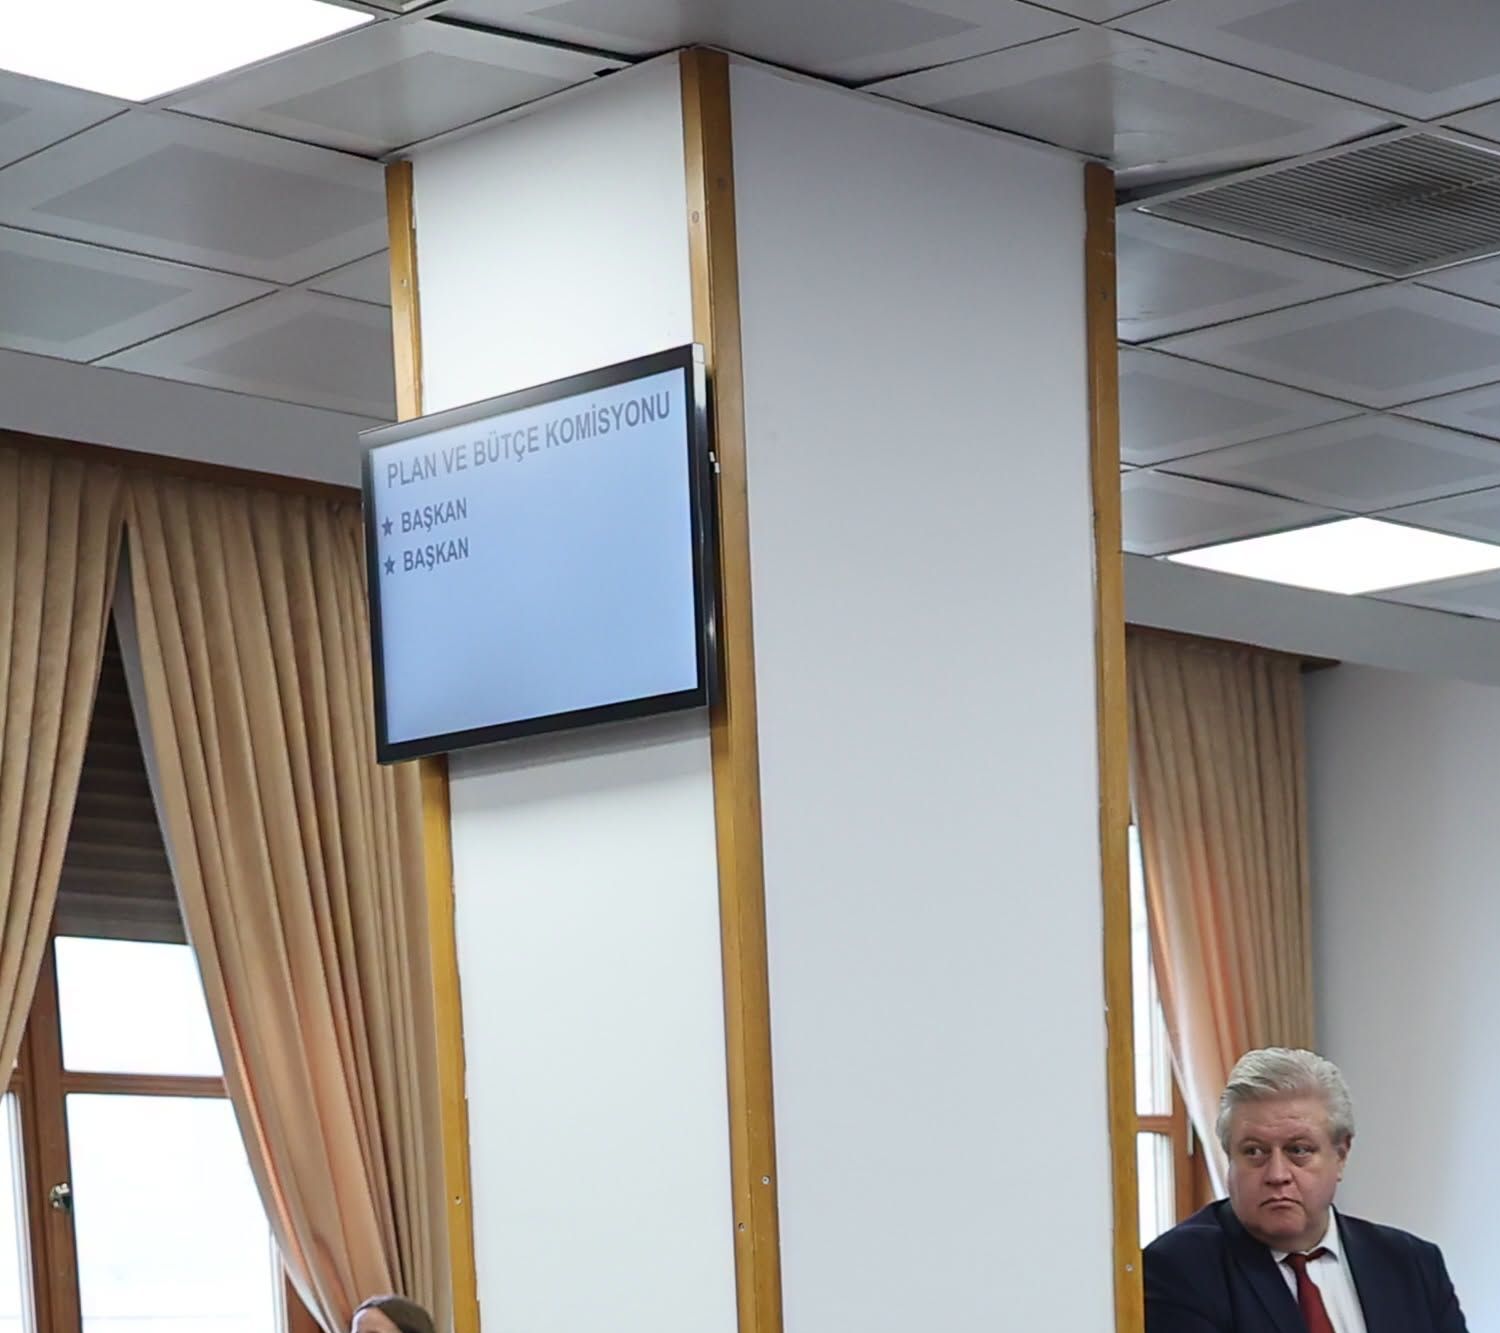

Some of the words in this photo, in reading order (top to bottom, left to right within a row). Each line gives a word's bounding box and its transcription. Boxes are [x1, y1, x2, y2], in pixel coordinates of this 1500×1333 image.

[387, 452, 437, 488] PLAN
[443, 445, 467, 474] VE
[474, 425, 539, 466] BÜTÇE
[546, 391, 670, 448] KOMİSYONU
[401, 498, 468, 534] BAŞKAN
[403, 537, 470, 572] BAŞKAN
